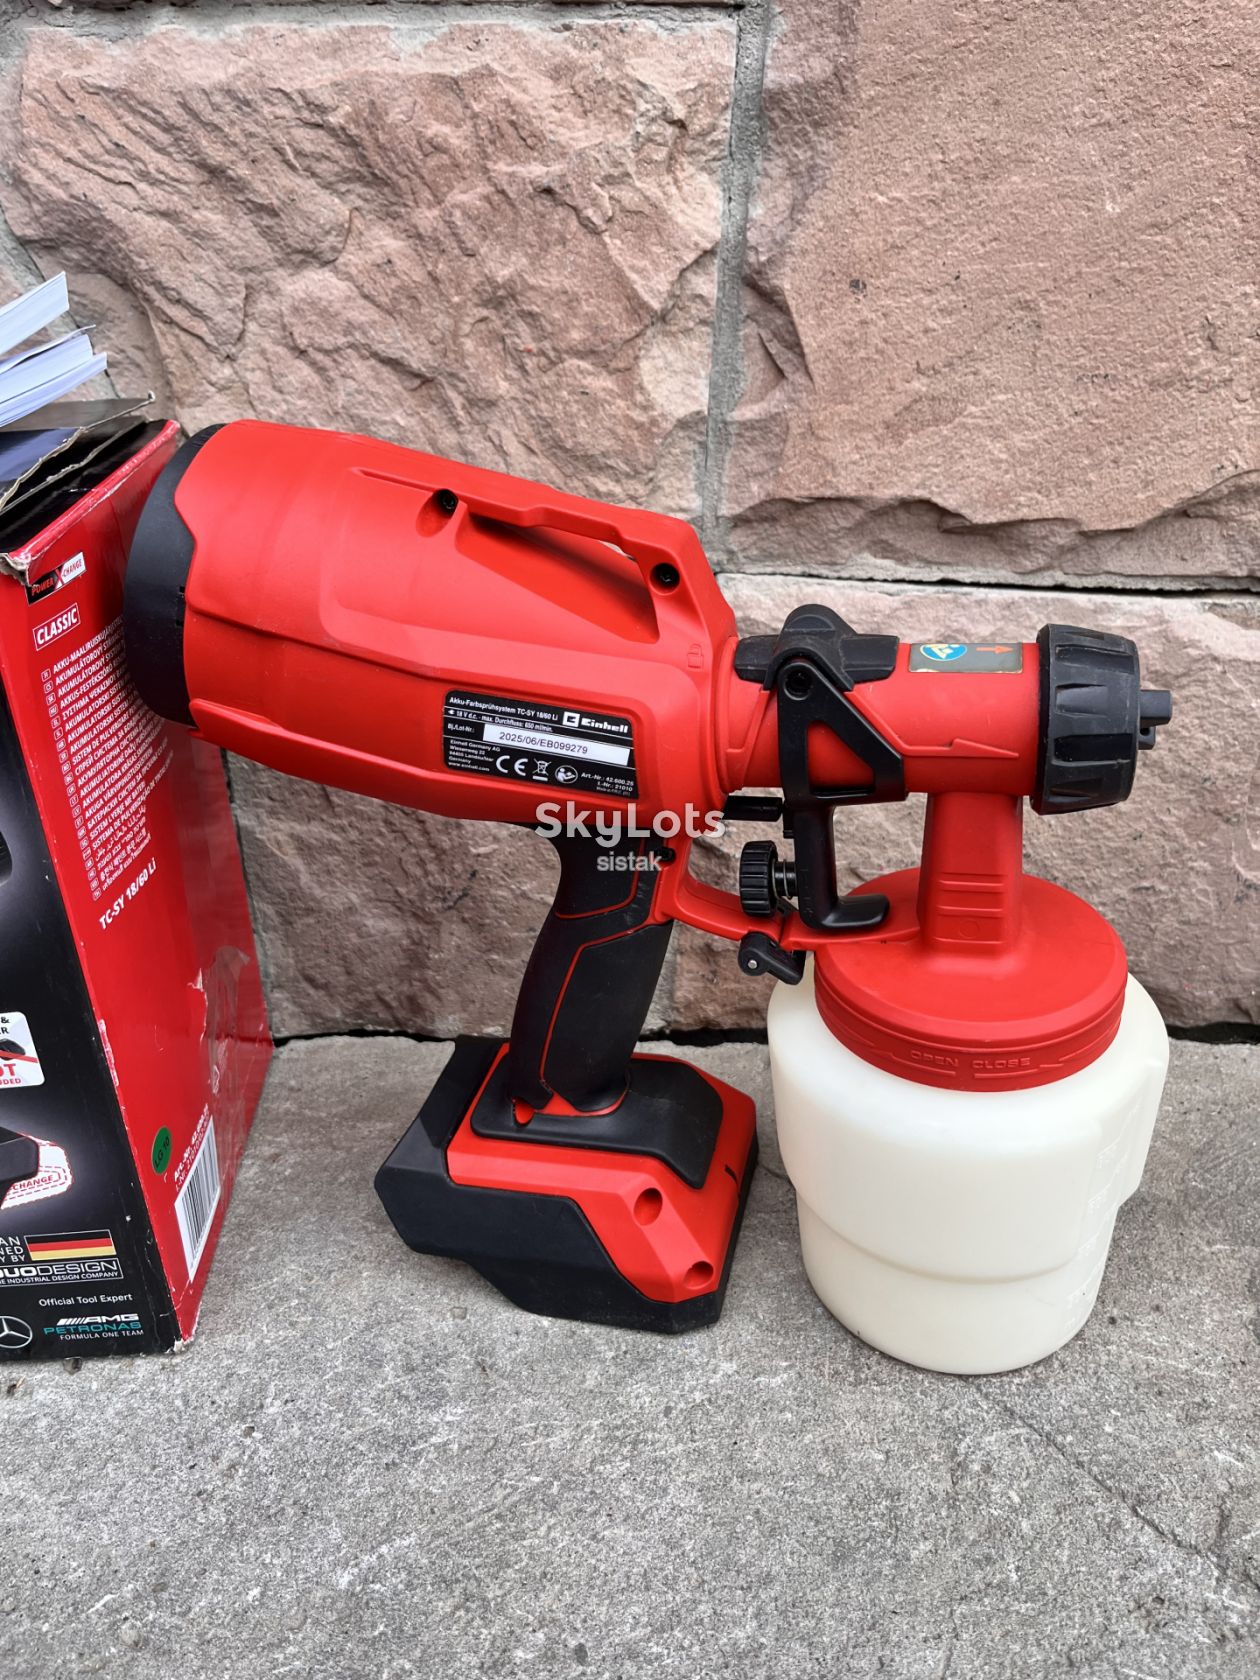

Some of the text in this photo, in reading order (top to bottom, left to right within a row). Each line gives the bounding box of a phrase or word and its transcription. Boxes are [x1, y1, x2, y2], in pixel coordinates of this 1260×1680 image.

[37, 608, 77, 645] CLASSIC
[65, 692, 111, 732] AKUMULATORSKI
[449, 697, 516, 714] Akku-Farbsprühsystem
[517, 708, 535, 717] TC-SY
[68, 703, 112, 743] AKUMULATORSKI
[70, 713, 115, 755] AKUMULATORSKI
[580, 717, 629, 734] Einhell
[72, 744, 93, 765] SISTEM
[91, 738, 101, 750] DE
[499, 731, 588, 755] 2025/06/EB099279
[83, 769, 122, 809] AKUMULATORA
[99, 894, 125, 931] TC-SY
[126, 867, 149, 901] 18/60
[911, 1050, 1031, 1070] OPEN CLOSE
[154, 1150, 164, 1168] LG
[7, 1275, 51, 1284] INDUSTRIAL
[52, 1273, 80, 1281] DESIGN
[81, 1271, 119, 1280] COMPANY
[39, 1293, 133, 1307] Official Tool Expert
[43, 1321, 142, 1336] PETRONAS
[60, 1332, 100, 1341] FORMULA
[121, 1329, 144, 1337] TEAM
